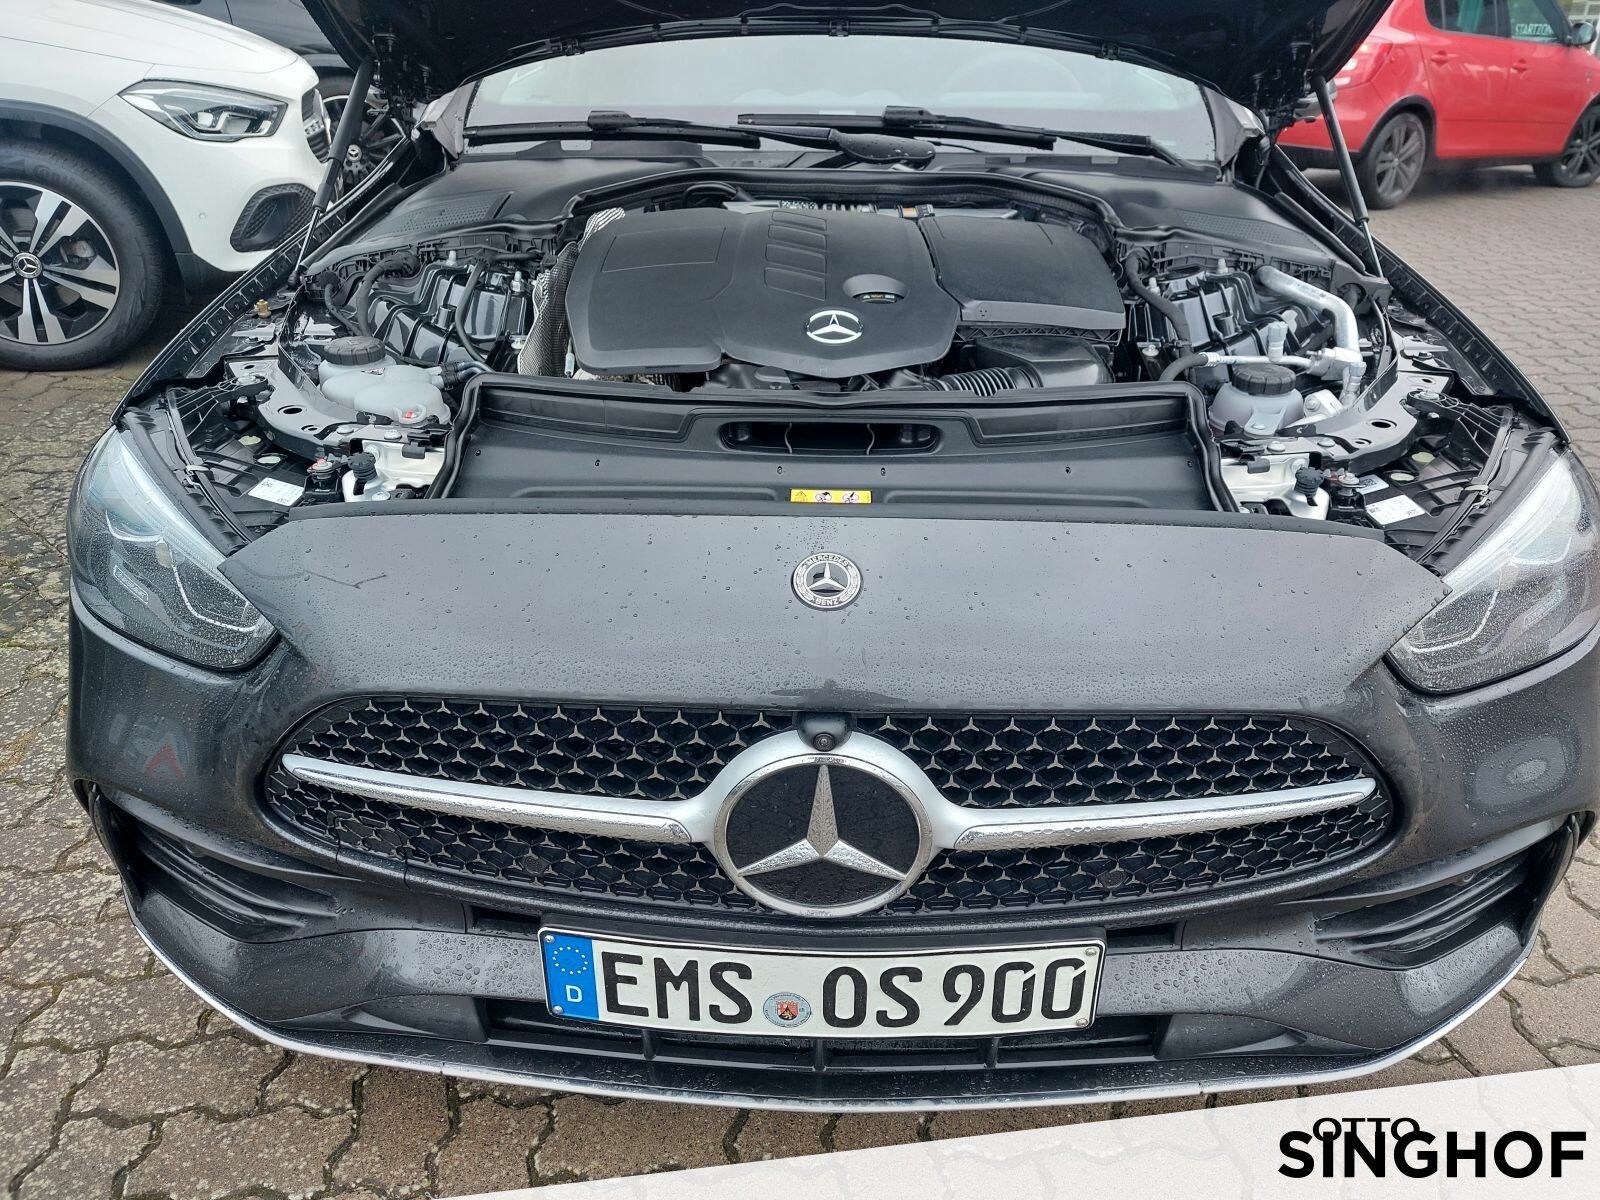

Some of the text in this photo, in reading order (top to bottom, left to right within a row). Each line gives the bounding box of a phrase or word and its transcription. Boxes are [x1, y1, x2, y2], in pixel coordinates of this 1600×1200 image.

[806, 554, 849, 568] MERCEDES
[815, 598, 840, 606] BENZ
[565, 984, 583, 1003] D
[601, 951, 754, 1023] EMS
[821, 966, 923, 1029] OS
[942, 957, 1086, 1027] 900
